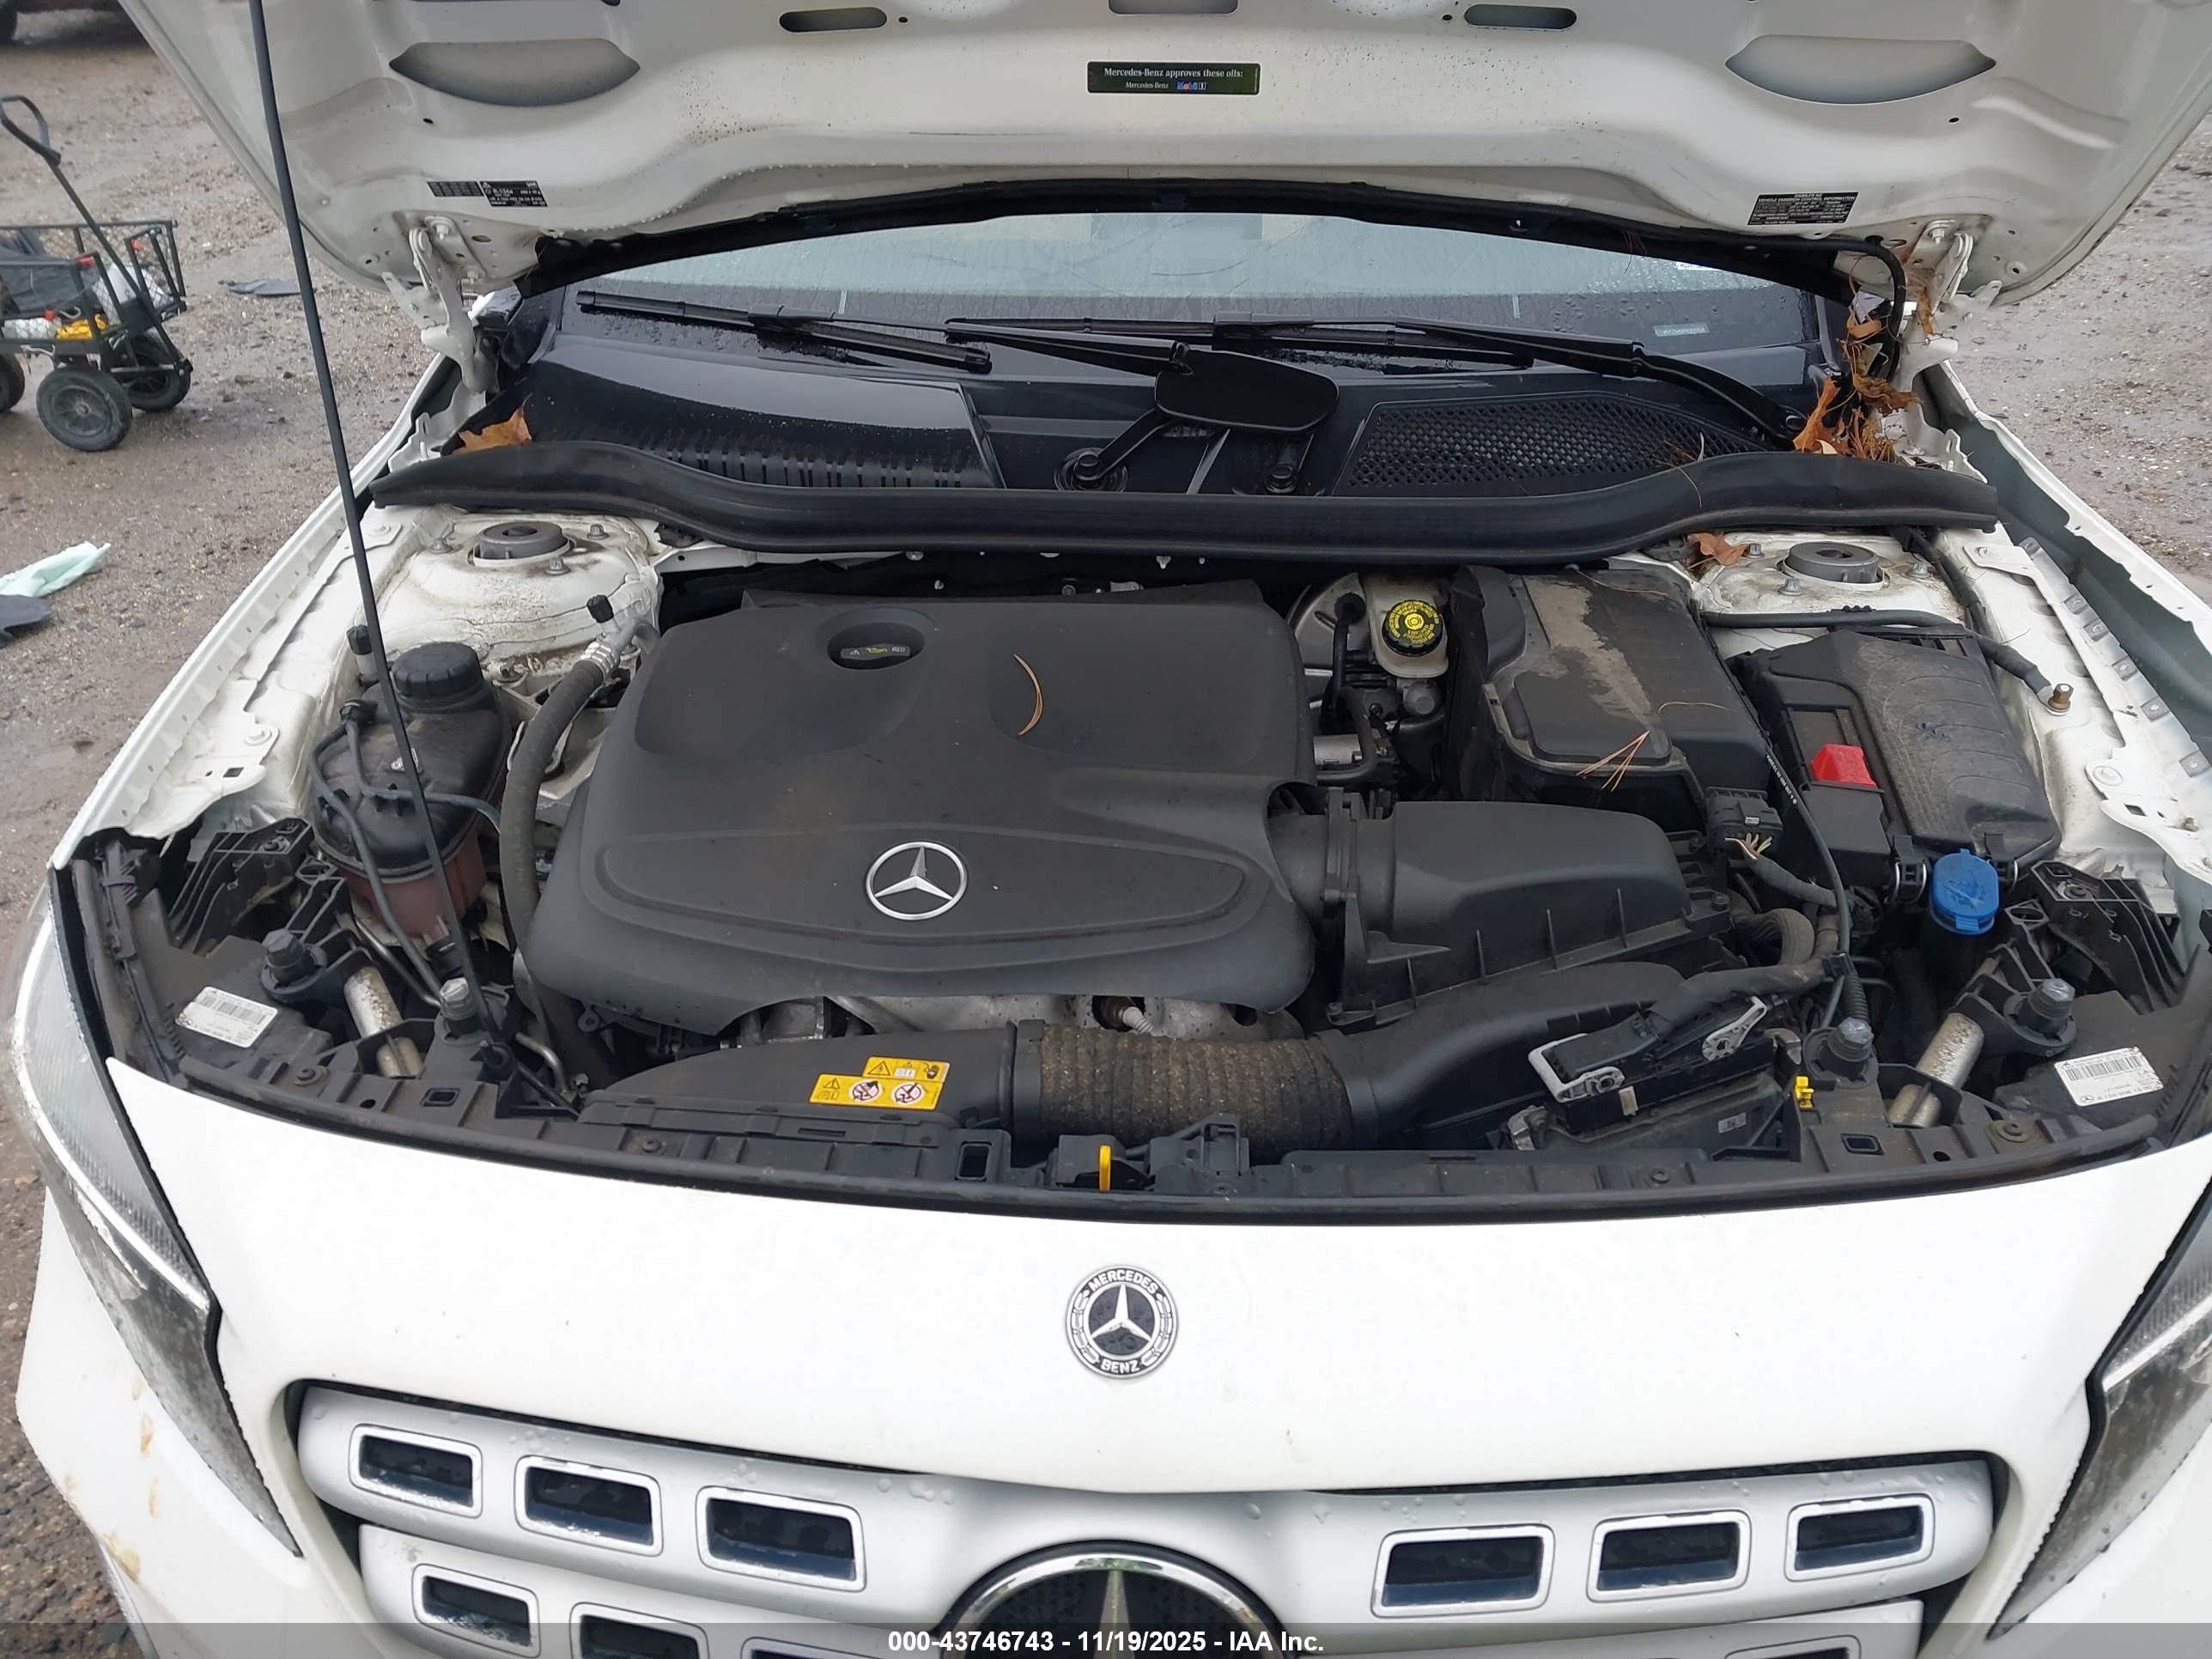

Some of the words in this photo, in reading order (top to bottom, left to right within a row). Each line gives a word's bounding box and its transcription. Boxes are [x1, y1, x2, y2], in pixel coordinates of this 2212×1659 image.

[1104, 68, 1164, 76] Mercedes-Benz
[1165, 70, 1201, 79] approves
[1203, 69, 1224, 77] these
[1226, 69, 1243, 77] oils:
[1088, 1269, 1158, 1295] MERCEDES
[1100, 1358, 1140, 1374] BENZ
